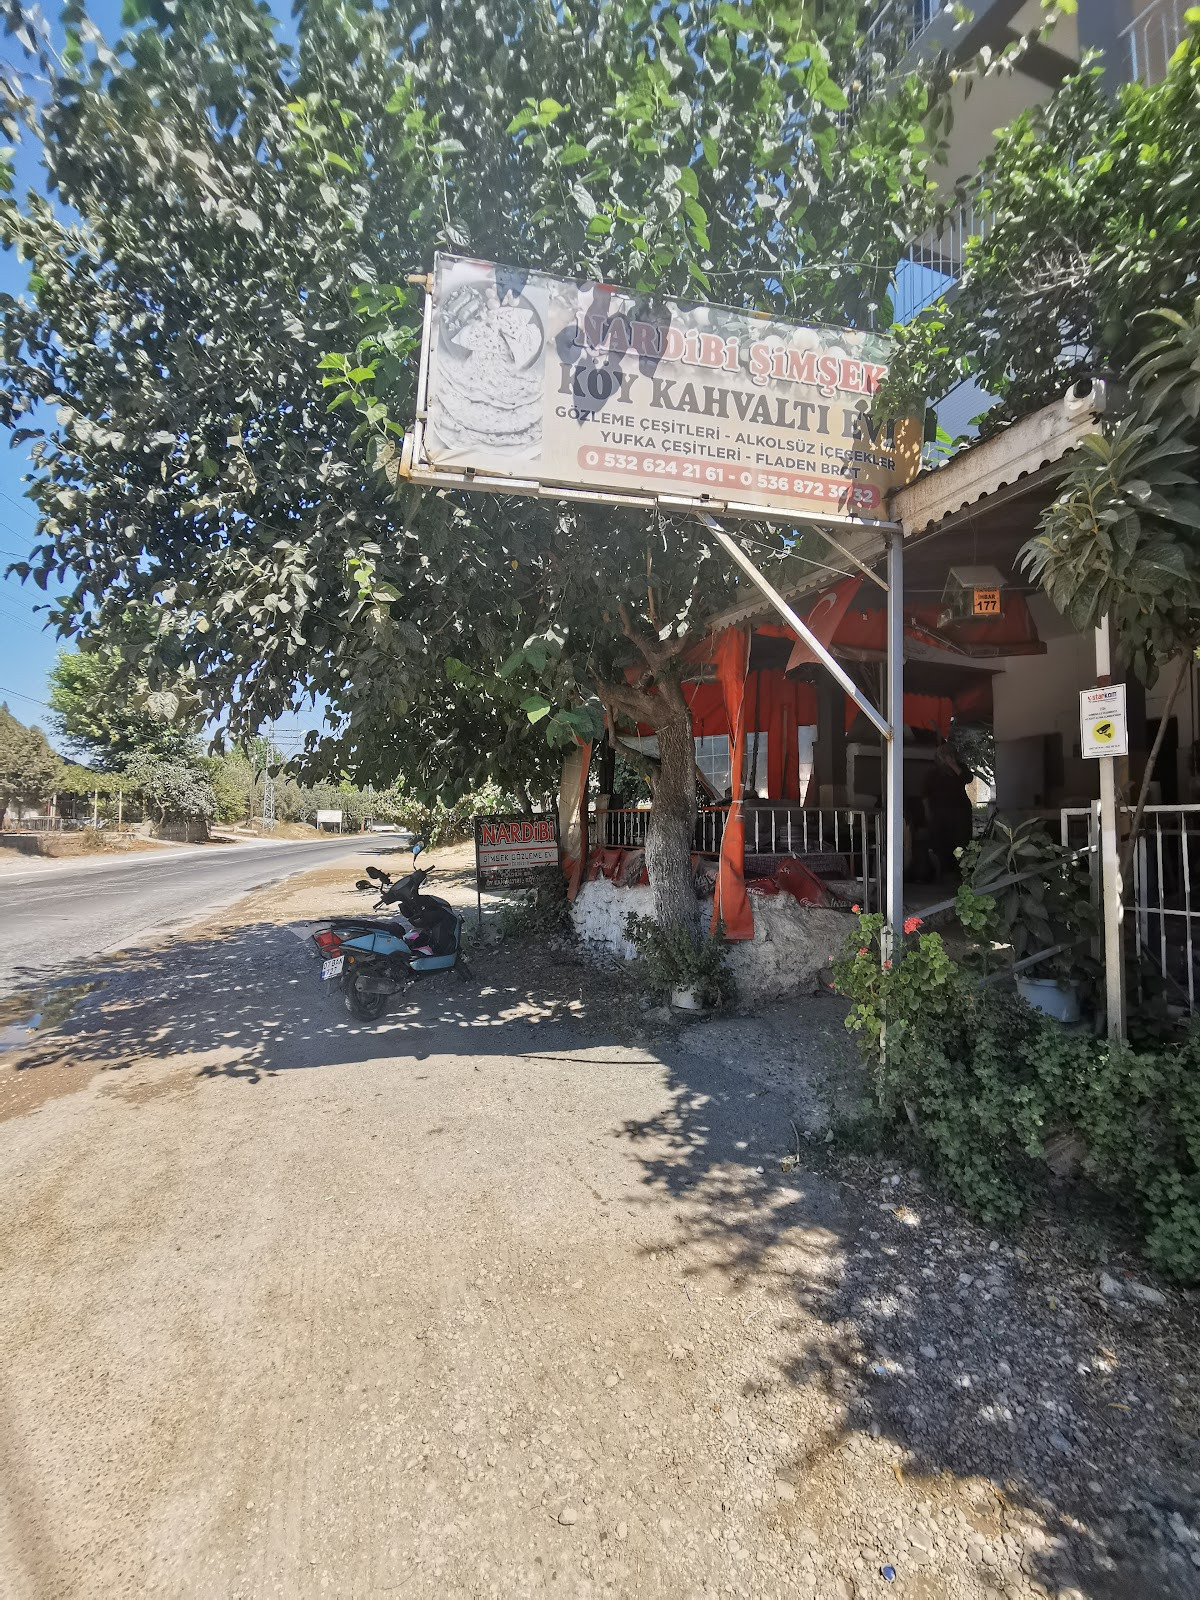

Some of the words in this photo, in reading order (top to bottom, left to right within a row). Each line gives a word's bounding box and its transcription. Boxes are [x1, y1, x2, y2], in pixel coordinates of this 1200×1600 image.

[558, 359, 639, 404] KÖY
[649, 377, 831, 435] KAHVALTI
[555, 404, 635, 428] GÖZLEME
[639, 417, 720, 440] ÇEŞİTLERİ
[735, 432, 816, 455] ALKOLSÜZ
[601, 430, 656, 449] YUFKA
[661, 438, 741, 461] ÇEŞİTLERİ
[755, 453, 816, 472] FLADEN
[821, 463, 861, 479] BROT
[585, 451, 599, 465] 0
[604, 453, 638, 471] 532
[643, 458, 678, 475] 624
[682, 463, 700, 478] 21
[705, 467, 724, 482] 61
[740, 471, 752, 486] 0
[757, 474, 789, 491] 536
[793, 479, 824, 496] 872
[853, 488, 873, 503] 32
[977, 600, 997, 611] 177
